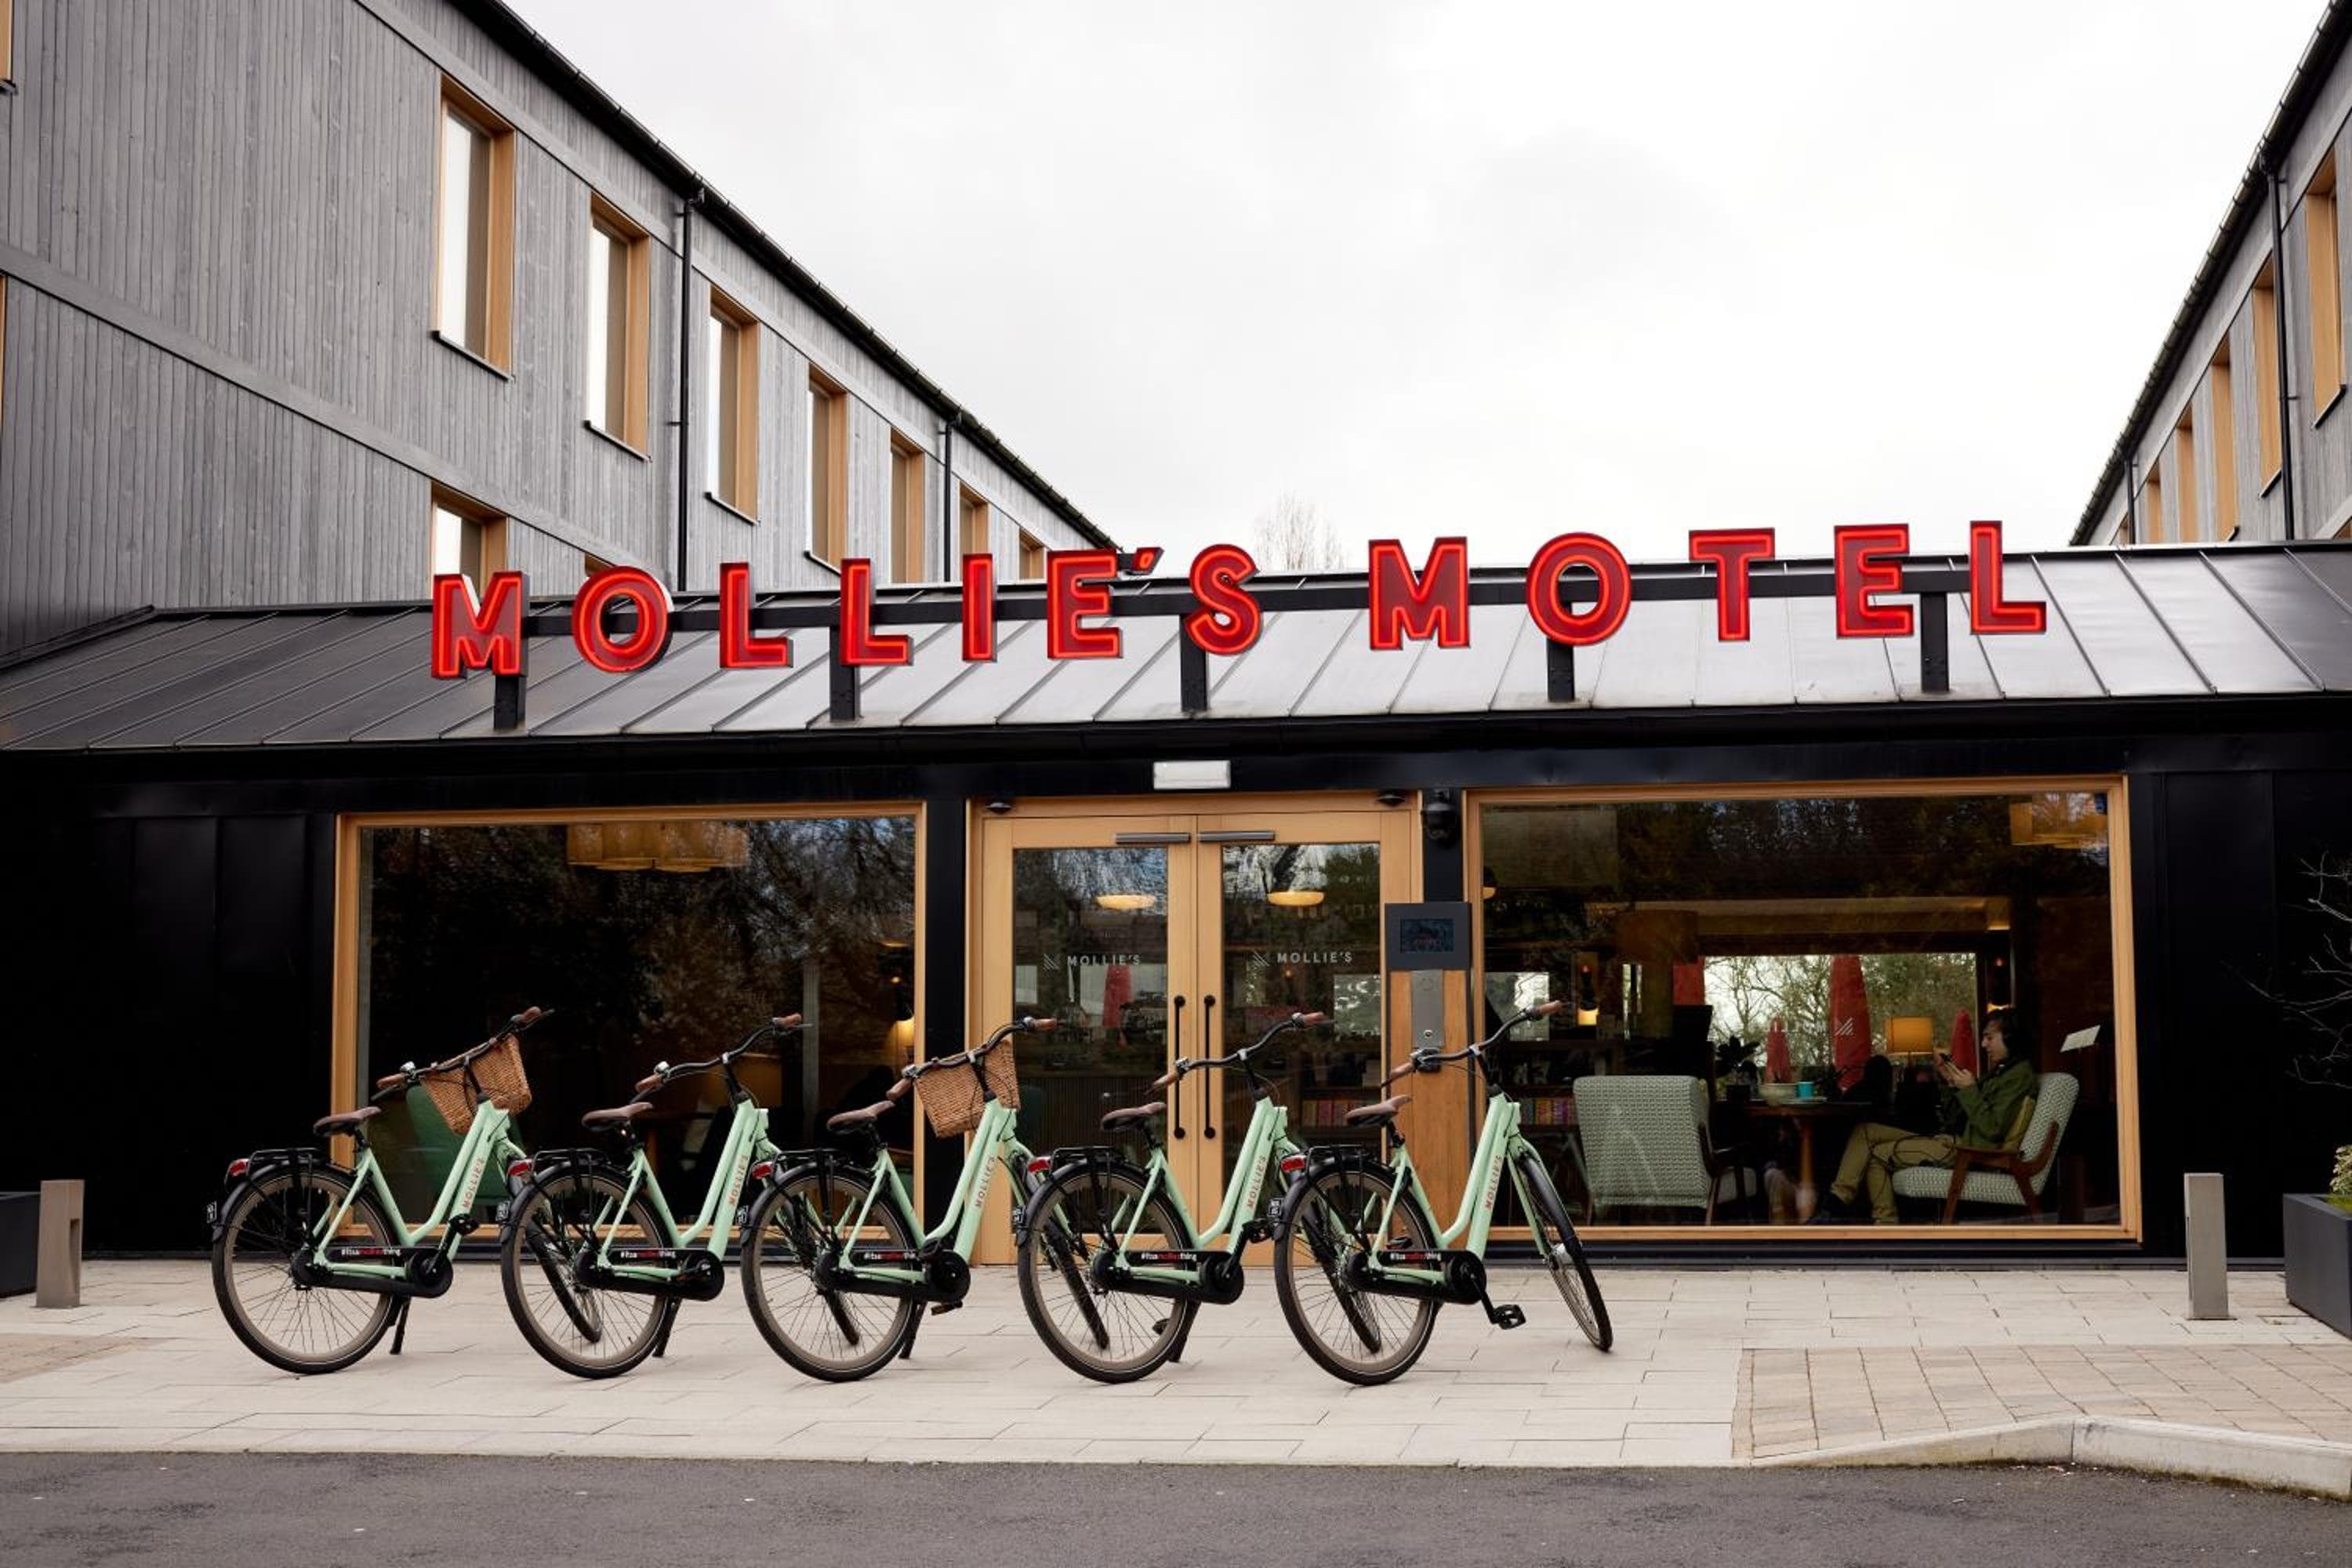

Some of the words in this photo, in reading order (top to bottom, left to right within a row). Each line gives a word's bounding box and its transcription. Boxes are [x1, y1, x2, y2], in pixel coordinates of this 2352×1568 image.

[431, 543, 1264, 680] MOLLIE'S
[1368, 521, 2046, 651] MOTEL
[1067, 953, 1141, 966] MOLLIE'S
[1276, 951, 1352, 964] MOLLIE'S
